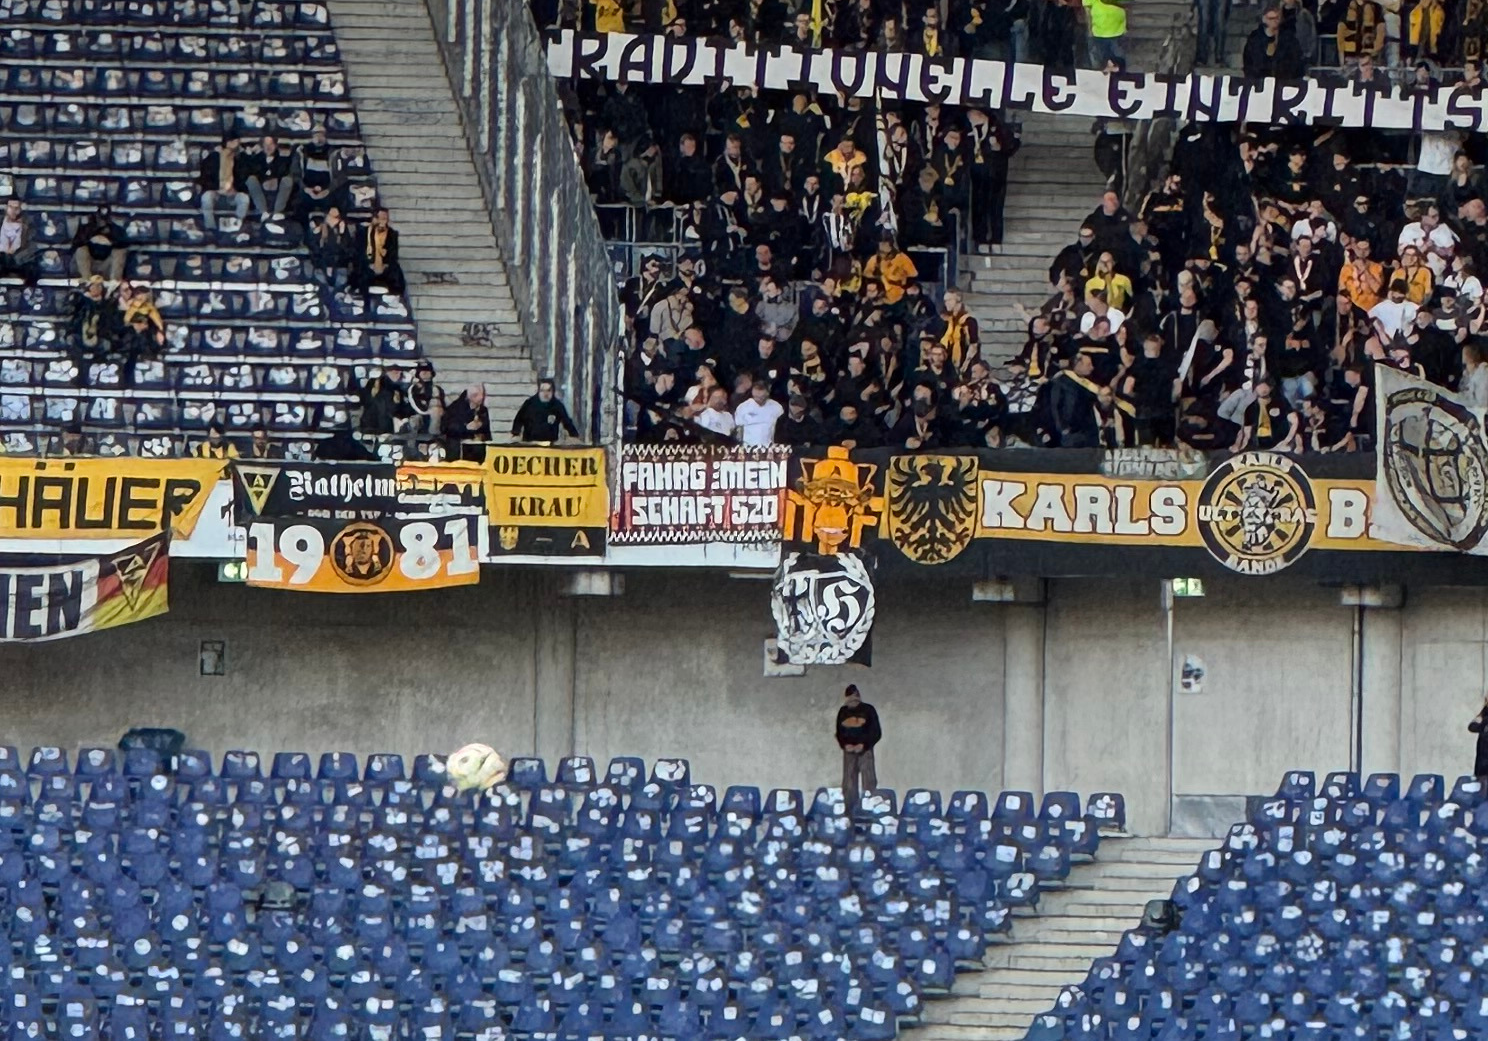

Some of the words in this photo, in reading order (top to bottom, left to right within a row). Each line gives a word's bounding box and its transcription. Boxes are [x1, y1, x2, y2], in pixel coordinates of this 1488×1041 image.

[493, 454, 598, 478] OECHER
[509, 496, 583, 518] KRAU
[632, 495, 726, 526] SCHAFT
[732, 495, 778, 525] 520
[982, 479, 1187, 536] KARLS
[249, 522, 325, 584] 19
[400, 517, 480, 580] 81
[0, 570, 84, 639] EN
